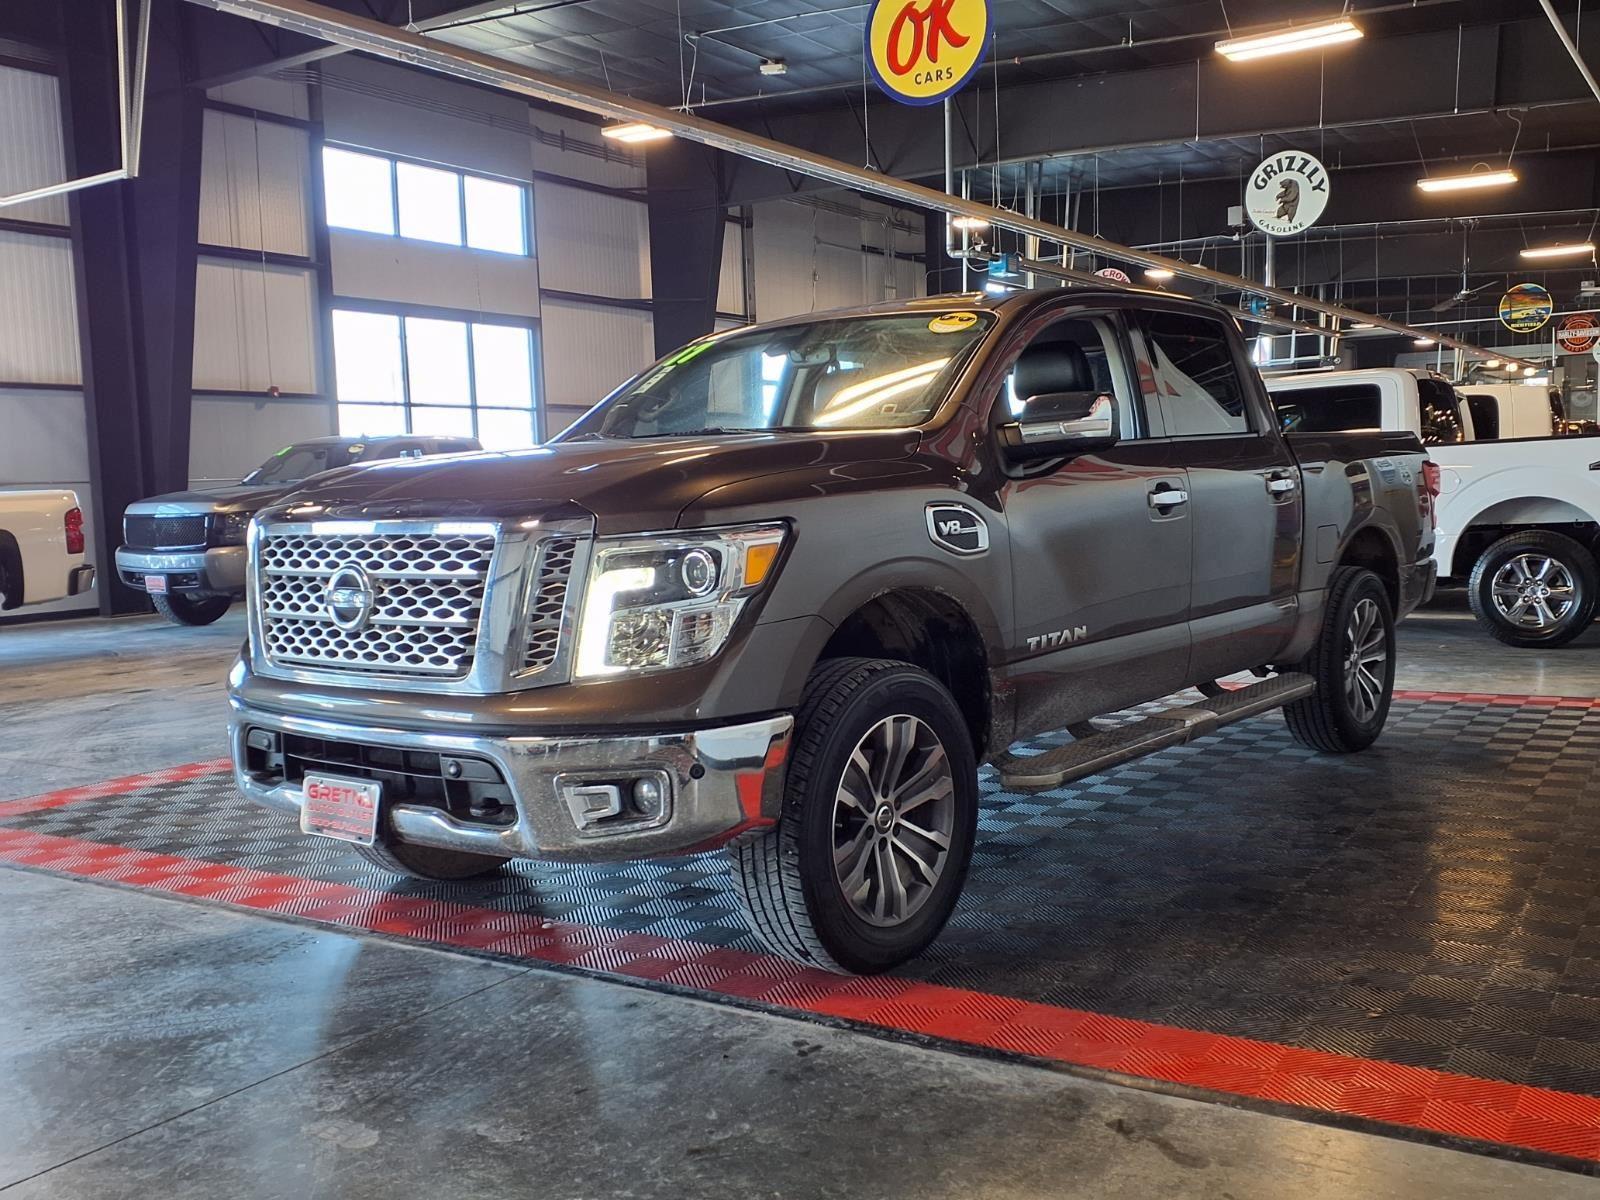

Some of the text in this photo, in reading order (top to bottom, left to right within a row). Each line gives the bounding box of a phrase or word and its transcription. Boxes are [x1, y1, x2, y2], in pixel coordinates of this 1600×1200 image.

[886, 0, 970, 76] OK
[914, 67, 953, 85] CARS
[1254, 155, 1326, 193] GRIZZLY
[1258, 219, 1305, 233] GASOLINE
[938, 520, 961, 536] V8
[1026, 625, 1088, 651] TITAN
